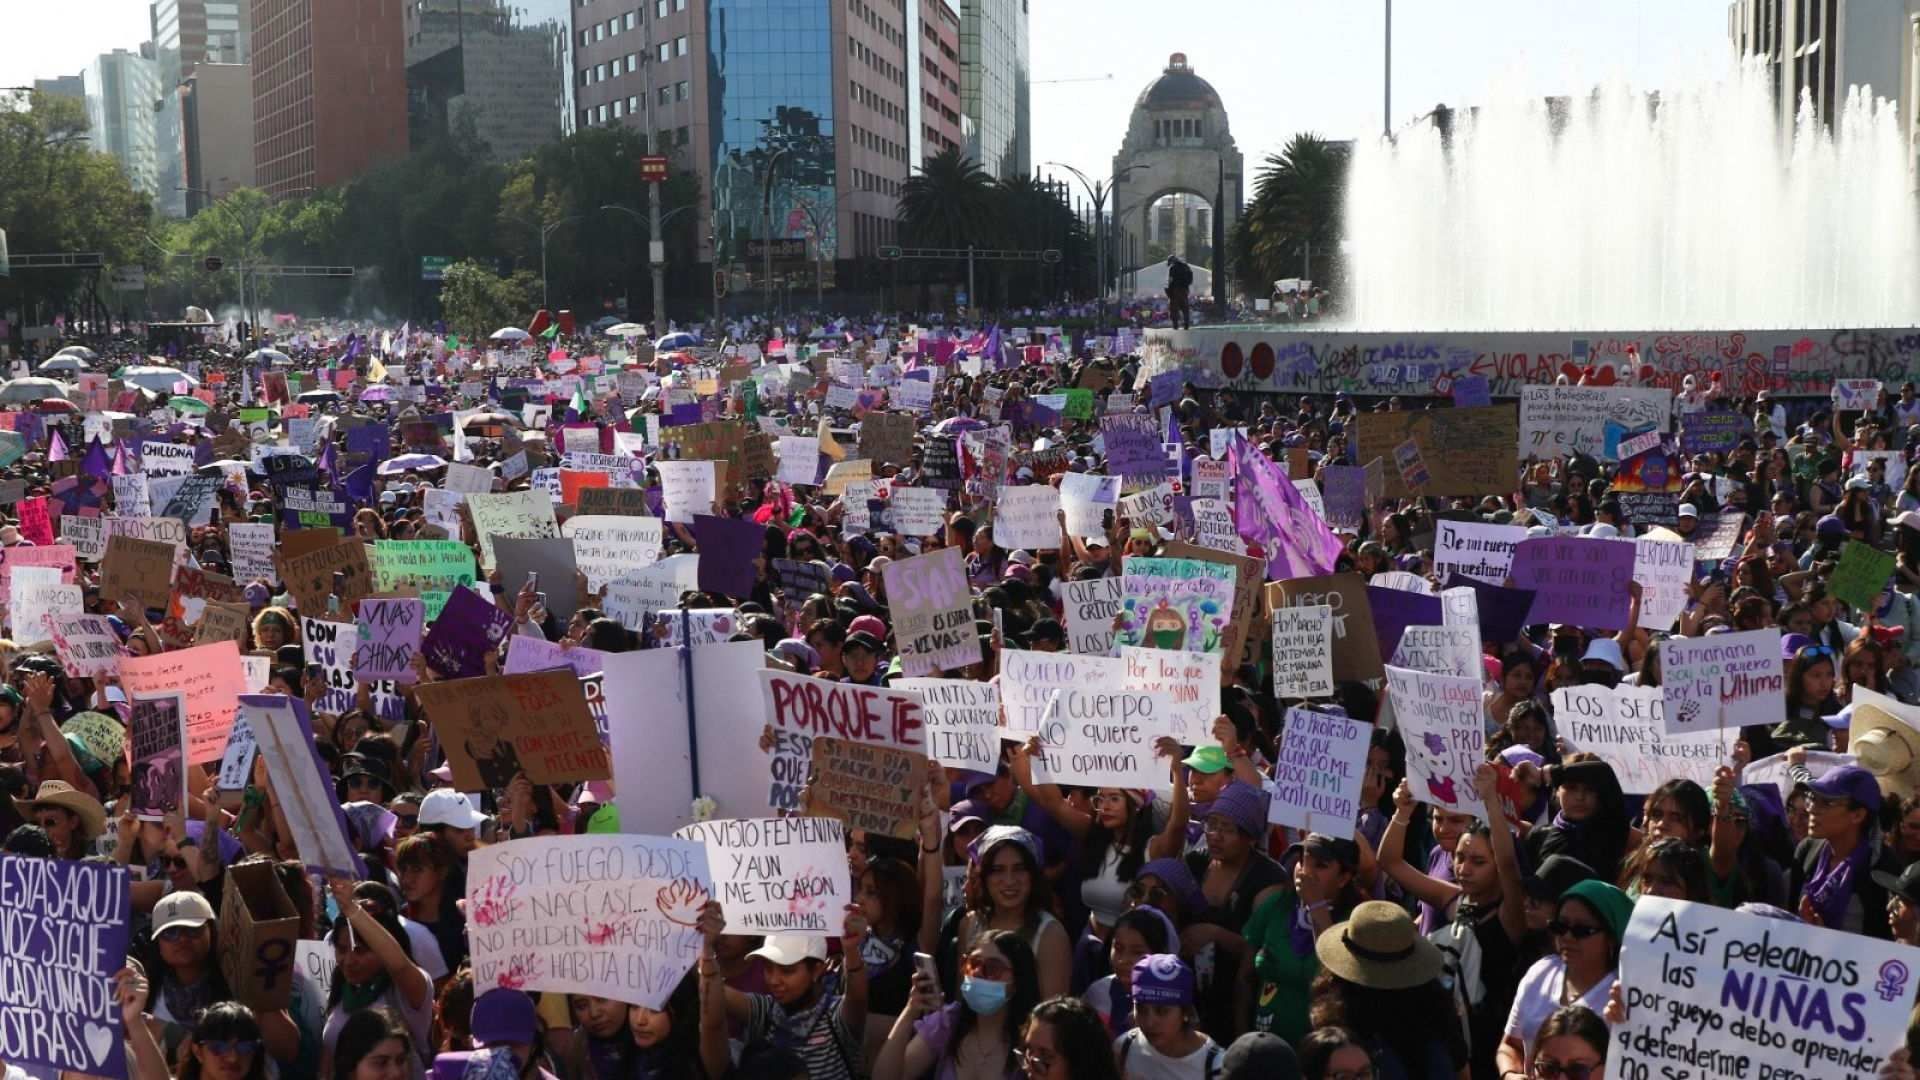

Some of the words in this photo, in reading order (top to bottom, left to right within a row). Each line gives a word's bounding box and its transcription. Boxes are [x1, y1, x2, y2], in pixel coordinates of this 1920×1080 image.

[142, 444, 194, 460] CHILLONA
[1138, 492, 1162, 513] UNA
[1442, 525, 1464, 550] De
[1466, 538, 1481, 551] mi
[1483, 540, 1519, 557] cuerp
[1436, 560, 1445, 579] y
[1461, 556, 1508, 579] vestuari
[611, 577, 654, 588] archando
[1068, 581, 1101, 603] QUE
[306, 618, 337, 643] CON
[913, 631, 961, 655] VIVAS
[1076, 633, 1106, 653] LOS
[1403, 629, 1473, 649] ERECEMOS
[356, 642, 413, 673] CHIDAS
[1668, 645, 1684, 666] Si
[1687, 643, 1756, 665] mañana
[1006, 653, 1076, 684] Quiero
[1127, 657, 1147, 680] Por
[1700, 663, 1721, 683] yo
[1724, 658, 1772, 681] quiero
[981, 687, 995, 703] YA
[1696, 679, 1713, 698] la
[770, 677, 886, 741] PORQUE
[886, 695, 922, 745] TE
[924, 708, 940, 726] OS
[1068, 690, 1153, 724] Cuerpo
[1564, 690, 1604, 718] LOS
[1619, 698, 1664, 722] SEC
[774, 729, 813, 758] ESP
[1082, 723, 1142, 748] quiere
[1285, 729, 1306, 749] POR
[1310, 739, 1331, 757] QUE
[1451, 728, 1482, 751] PRO
[1571, 720, 1661, 745] FAMILIARES
[932, 730, 991, 764] LIBRES
[1638, 742, 1727, 761] ENCUBREN
[1038, 754, 1062, 774] tu
[1072, 751, 1137, 777] opinión
[1330, 759, 1354, 779] ME
[1310, 770, 1321, 787] A
[1323, 774, 1342, 794] MI
[1312, 796, 1352, 820] CULPA
[496, 850, 541, 888] SOY
[543, 846, 625, 885] FUEGO
[632, 844, 699, 880] DESDE
[725, 881, 755, 905] ME
[41, 915, 112, 977] SIGUE
[475, 929, 506, 956] NO
[1650, 911, 1719, 956] Así
[1722, 930, 1860, 987] peleamos
[550, 949, 620, 987] HABITA
[627, 949, 651, 995] EN
[1661, 952, 1698, 989] las
[88, 975, 120, 1024] DE
[0, 1006, 88, 1071] OTRAS
[1626, 986, 1664, 1020] por
[1730, 1017, 1787, 1049] debo
[1791, 1037, 1884, 1074] aprender
[1632, 1026, 1751, 1079] defenderme
[1619, 1056, 1649, 1080] no
